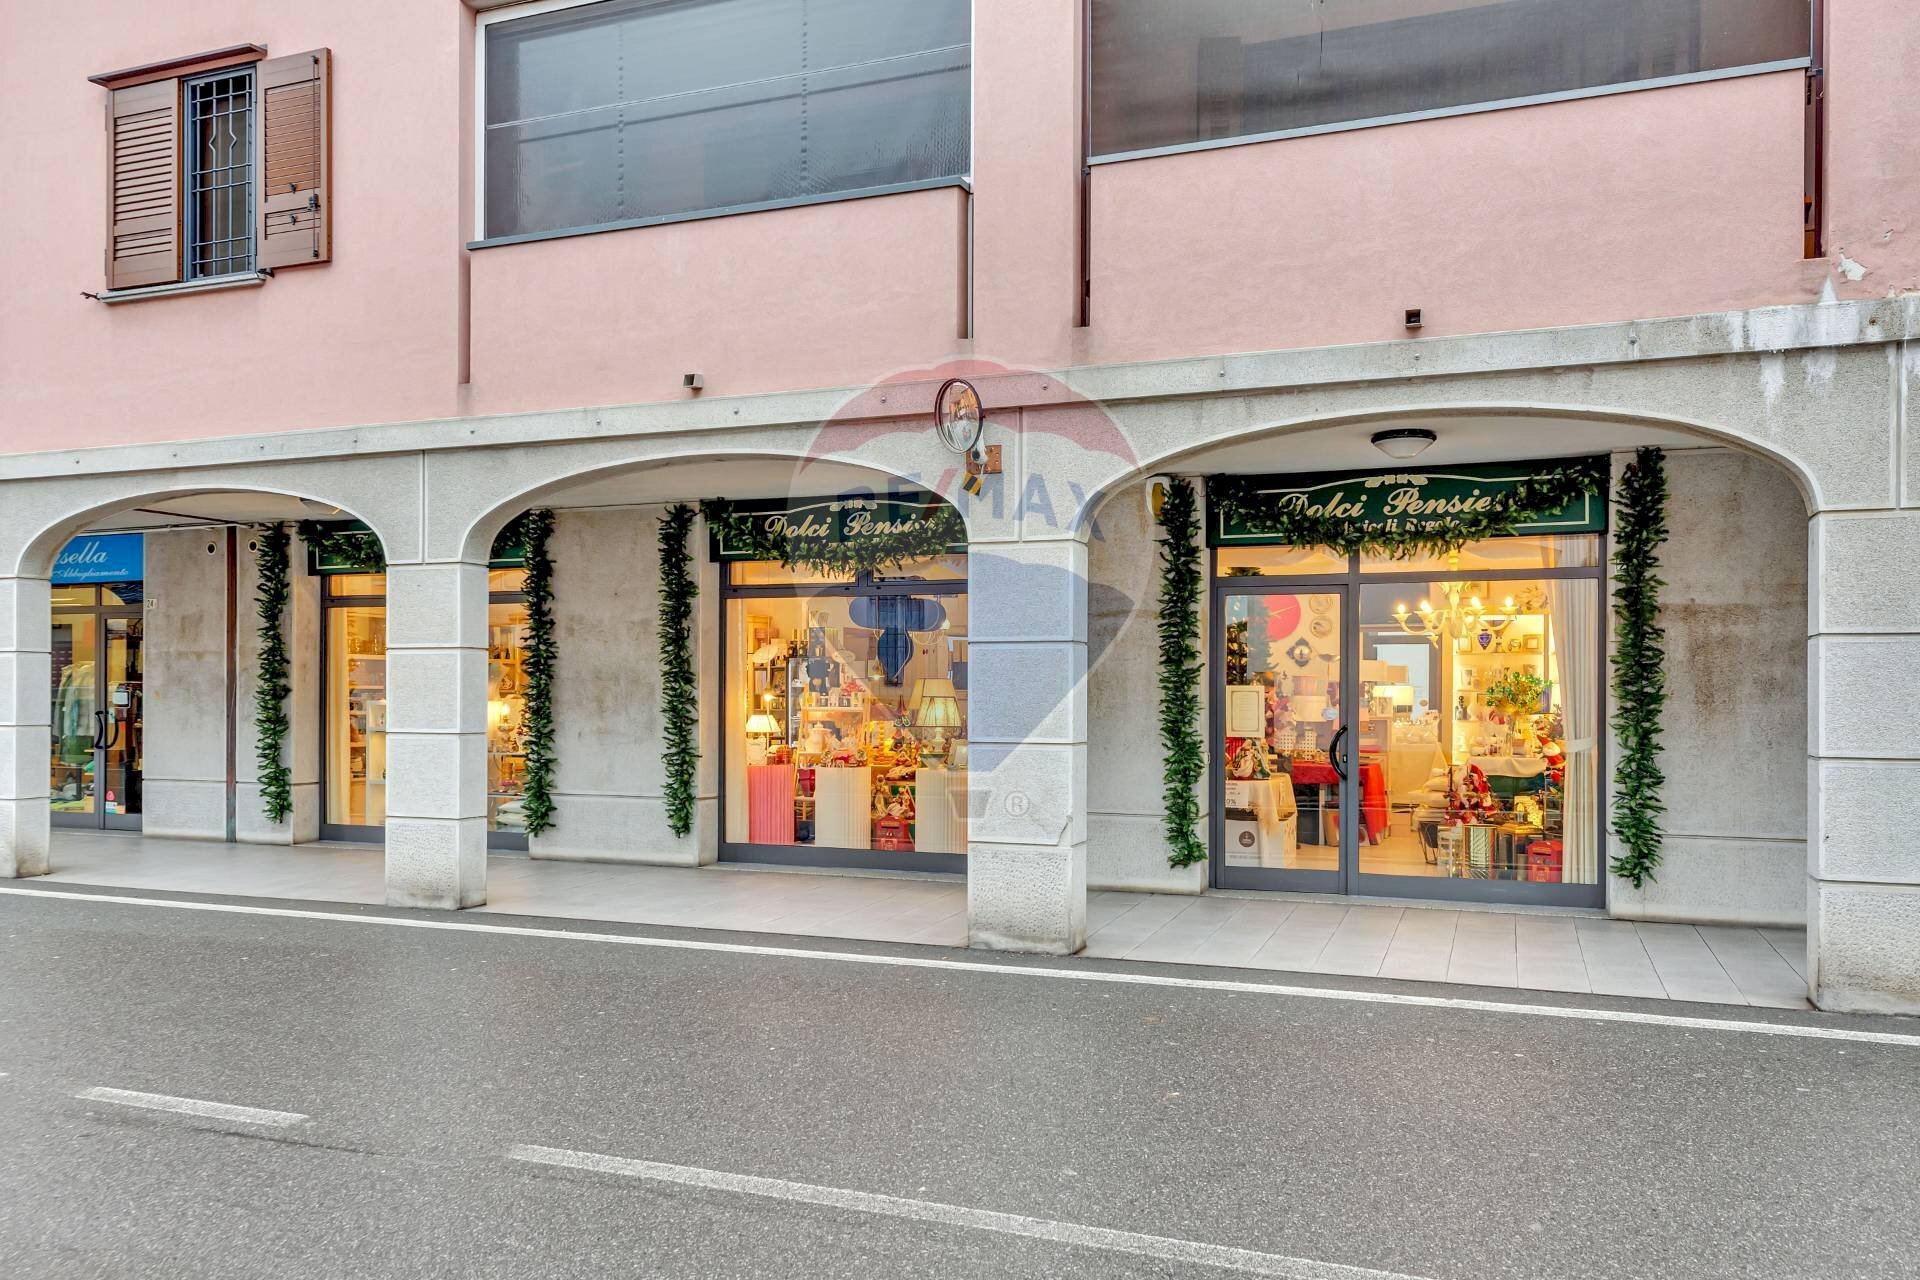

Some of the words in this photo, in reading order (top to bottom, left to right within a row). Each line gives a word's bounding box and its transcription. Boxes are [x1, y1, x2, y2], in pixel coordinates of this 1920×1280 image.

[1278, 491, 1368, 520] Dolci
[1383, 487, 1503, 516] Pensie
[764, 514, 832, 538] Dolci
